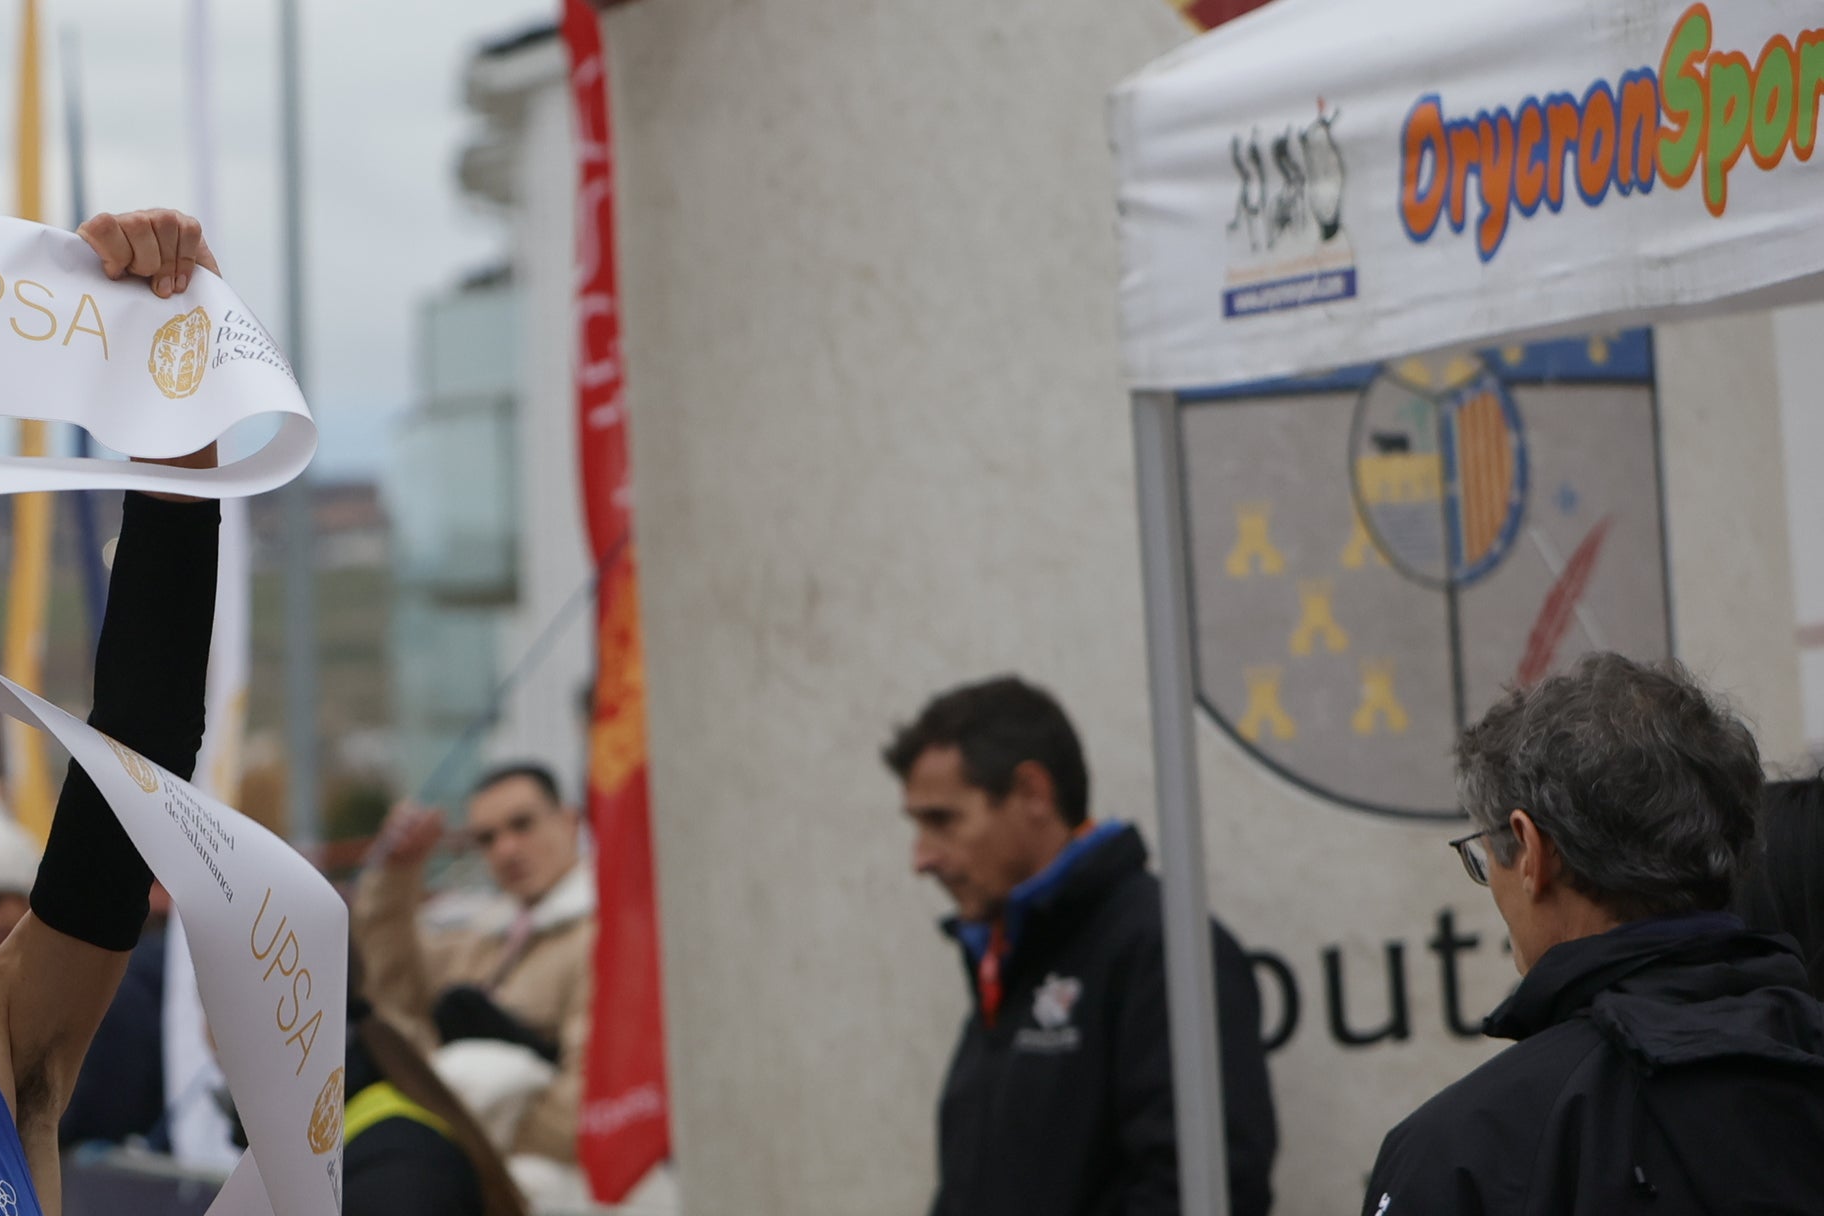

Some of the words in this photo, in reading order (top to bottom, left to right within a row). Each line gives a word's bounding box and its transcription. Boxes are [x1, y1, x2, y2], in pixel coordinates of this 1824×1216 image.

[157, 767, 235, 851] Universidad
[163, 781, 219, 854] Pontificia
[164, 801, 179, 824] de
[179, 815, 234, 904] Salamanca
[250, 887, 323, 1077] UPSA
